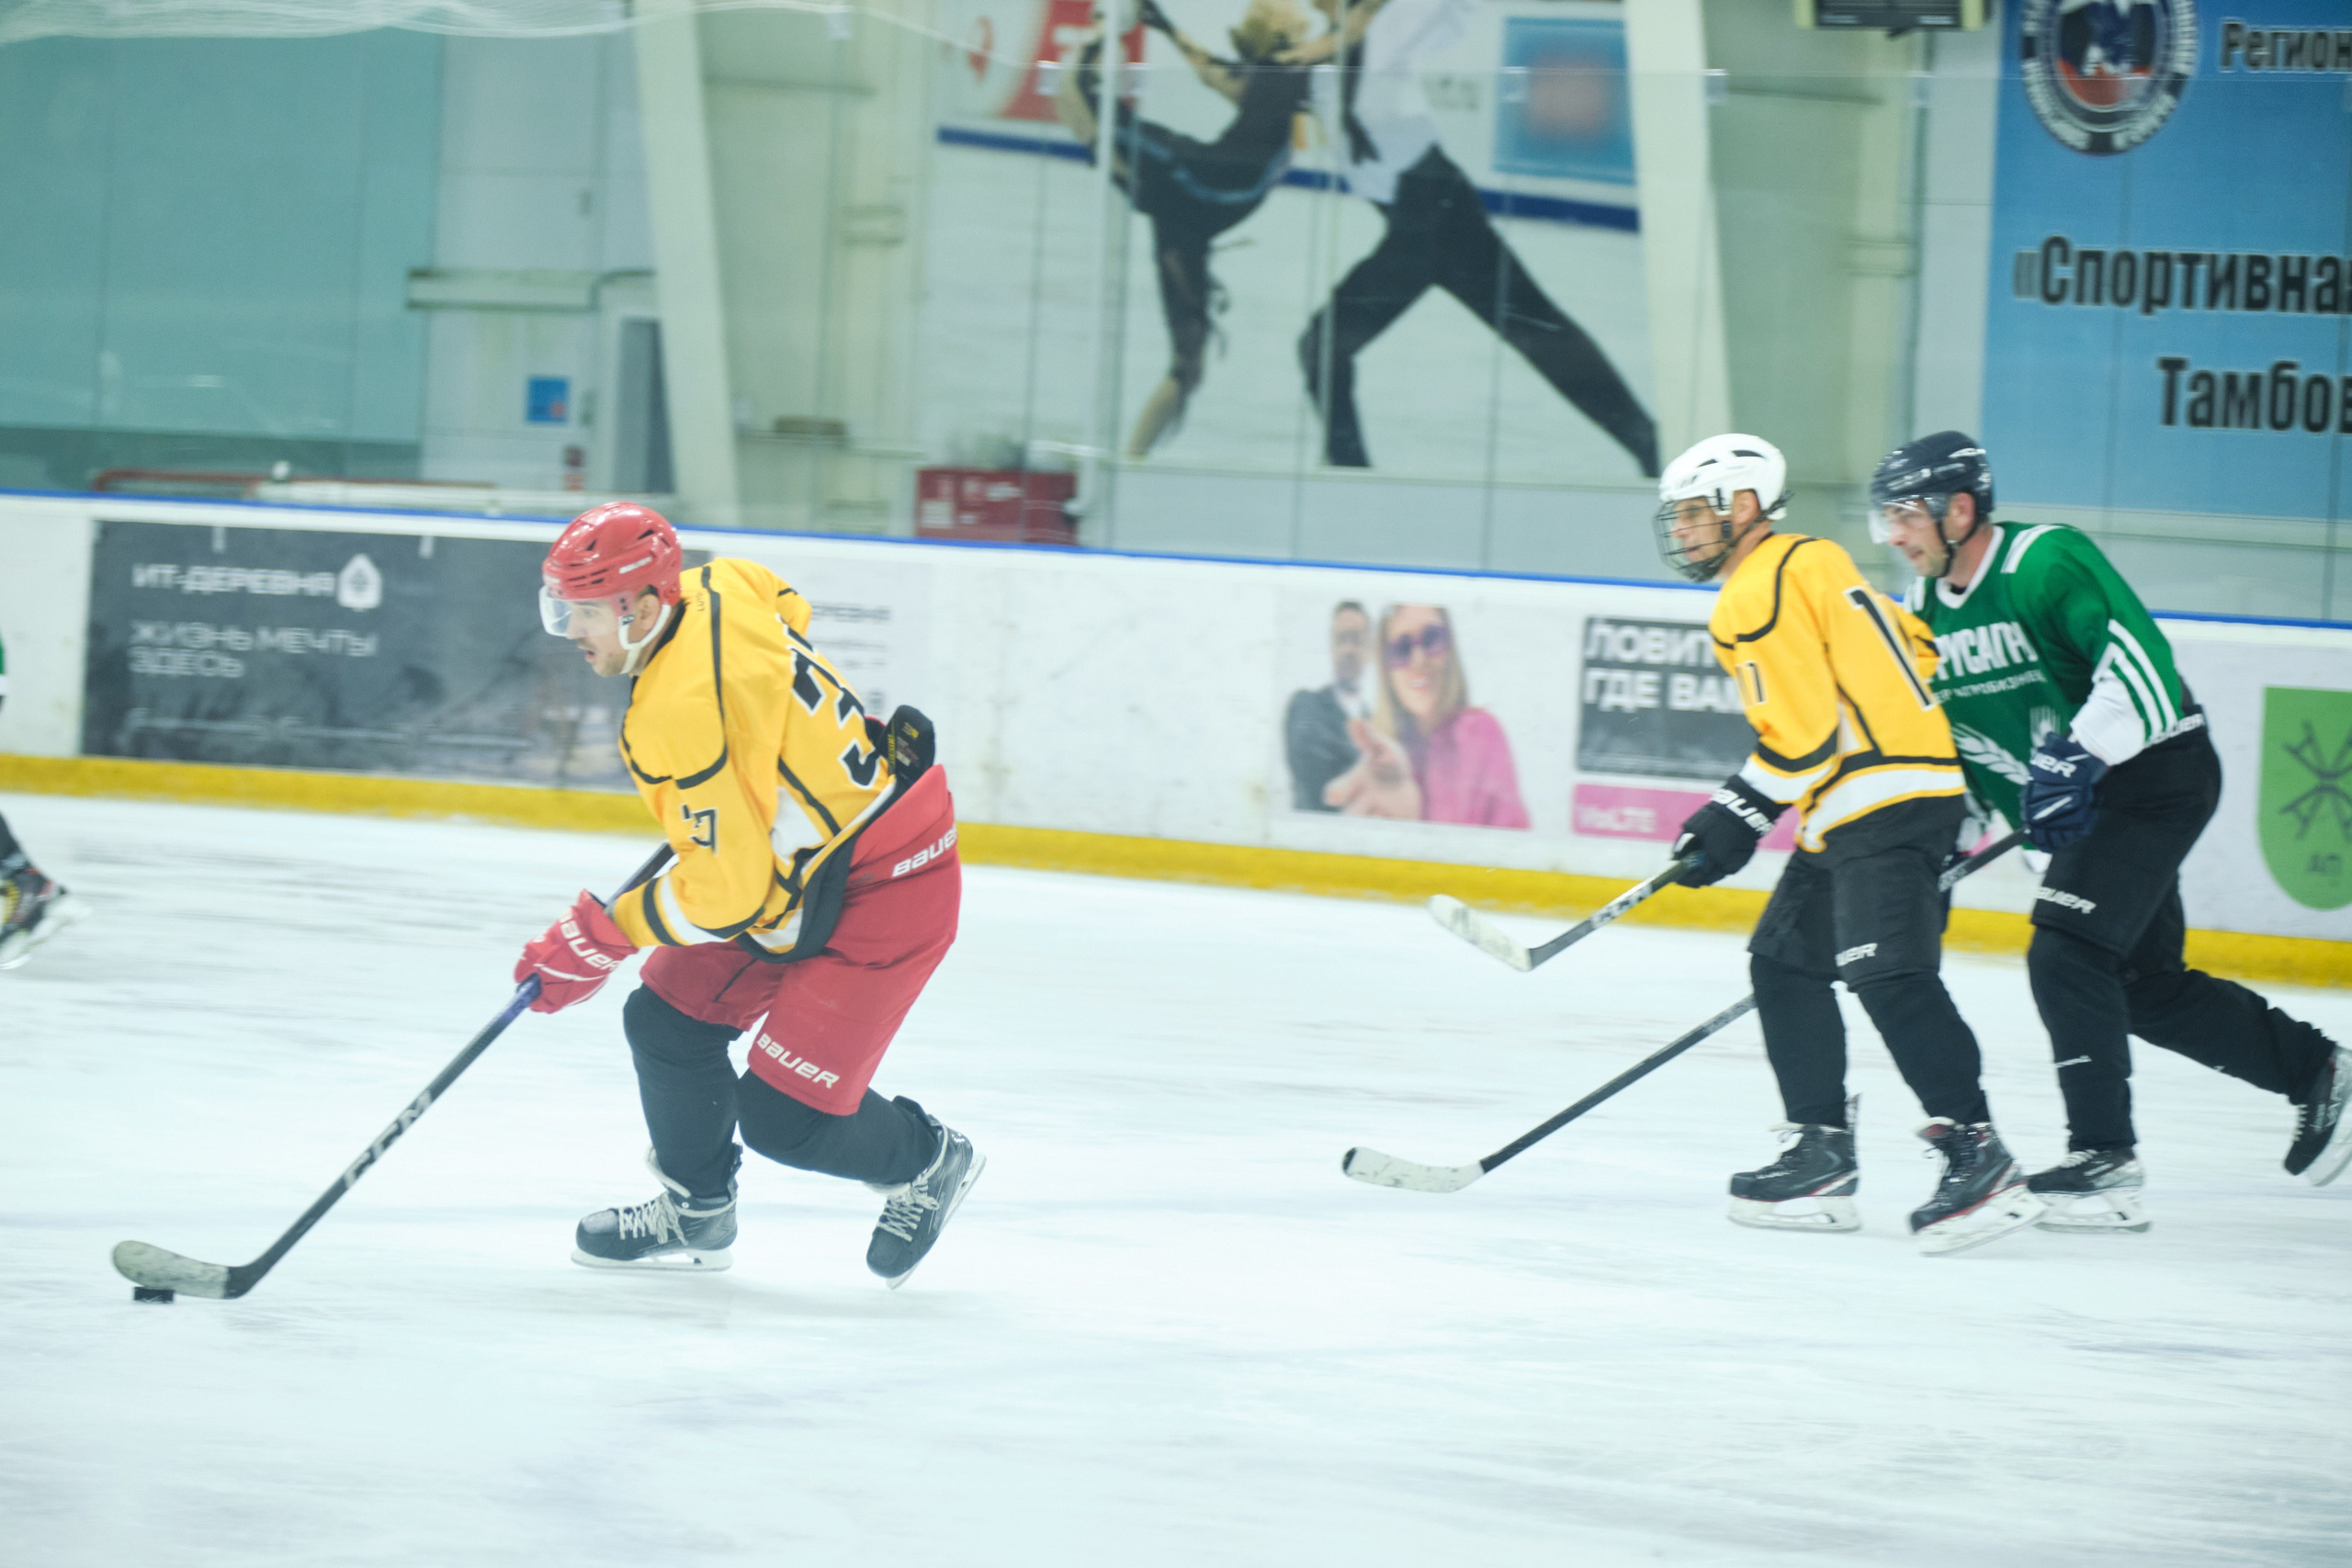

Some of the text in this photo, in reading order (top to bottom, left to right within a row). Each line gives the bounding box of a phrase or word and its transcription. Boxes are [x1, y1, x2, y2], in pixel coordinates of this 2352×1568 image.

[1841, 584, 1937, 712] 1
[1584, 668, 1661, 713] ГДЕ
[891, 822, 957, 878] BAUE
[2035, 886, 2098, 915] AUER
[756, 1032, 841, 1089] BAUER
